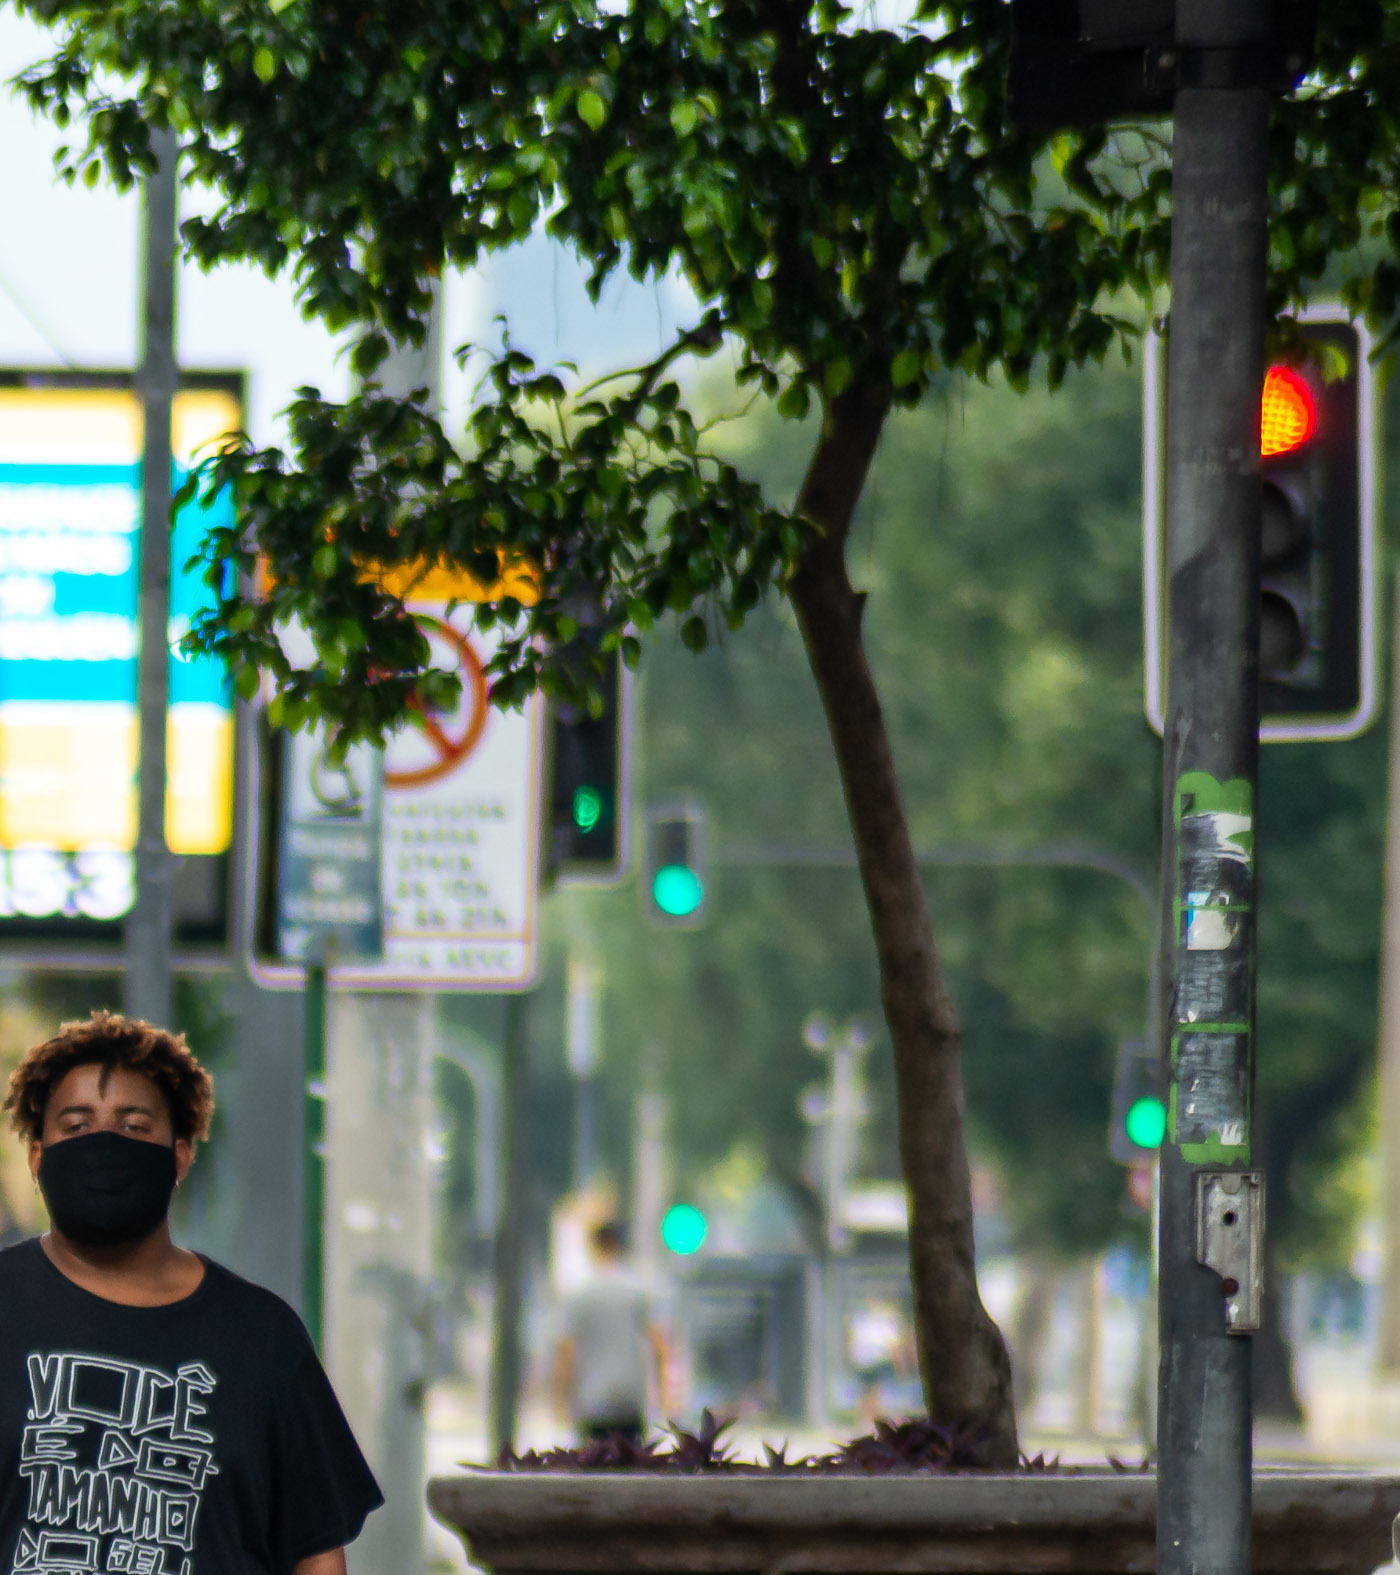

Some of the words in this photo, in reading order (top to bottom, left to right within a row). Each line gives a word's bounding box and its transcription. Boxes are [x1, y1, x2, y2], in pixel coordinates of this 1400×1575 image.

[28, 1353, 217, 1443] VOCÊ
[22, 1417, 85, 1463] É
[19, 1463, 200, 1552] TAMANHO
[15, 1529, 101, 1571] DO
